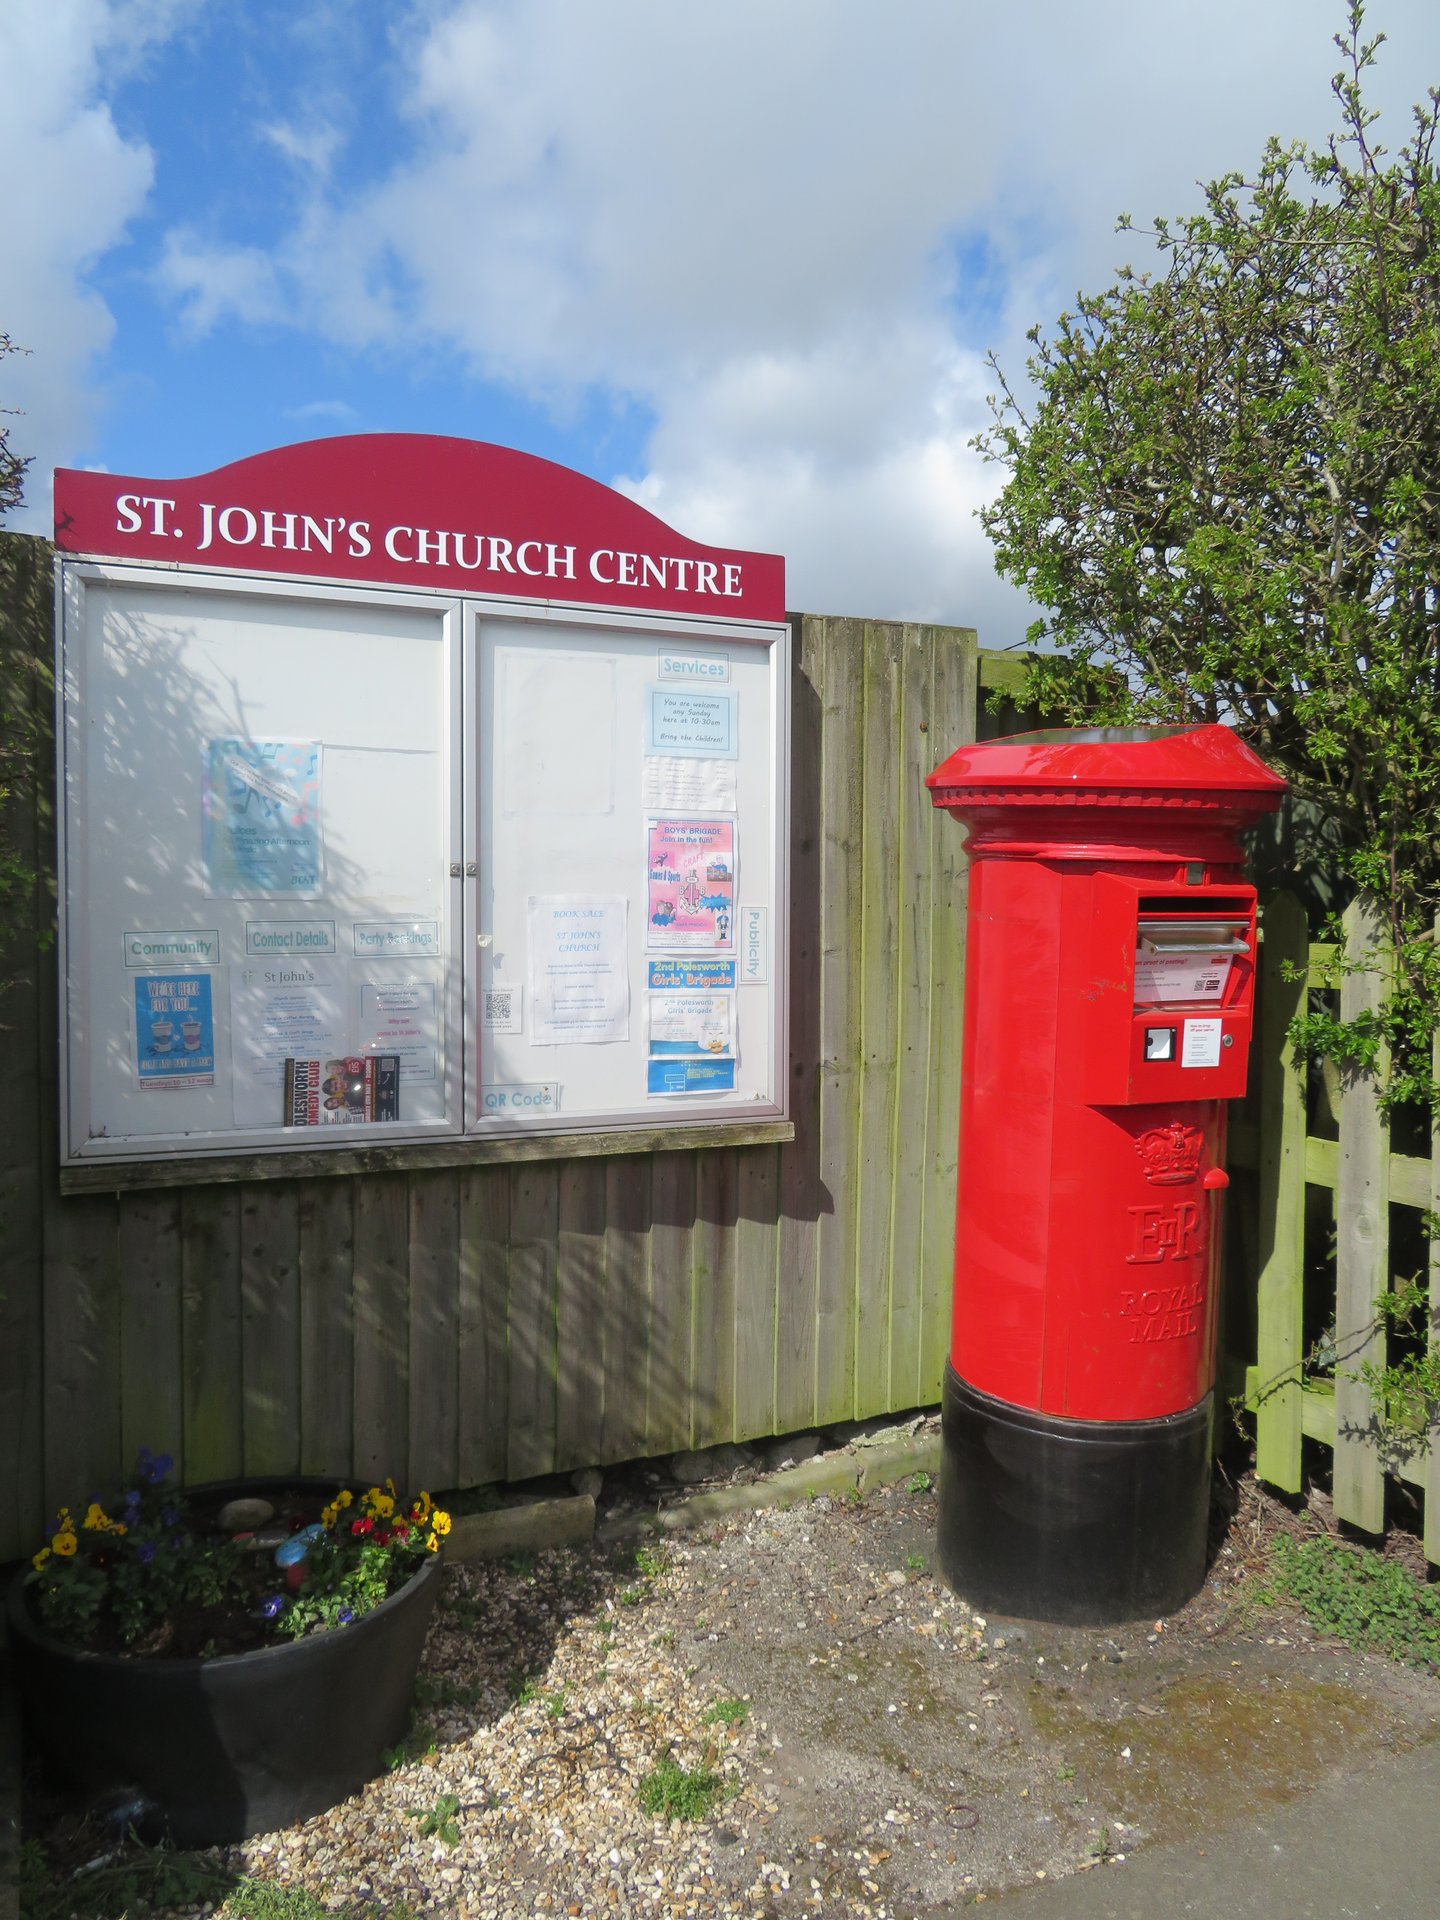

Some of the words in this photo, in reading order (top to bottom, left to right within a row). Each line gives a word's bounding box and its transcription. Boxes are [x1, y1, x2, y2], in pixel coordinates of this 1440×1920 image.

[116, 494, 183, 538] ST.
[197, 504, 371, 557] JOHN'S
[384, 526, 576, 580] CHURCH
[588, 549, 743, 598] CENTRE
[664, 657, 725, 676] Services
[664, 698, 677, 706] You
[693, 701, 720, 709] welcome
[662, 716, 677, 724] here
[673, 709, 684, 717] any
[688, 708, 711, 717] Sunday
[660, 733, 678, 741] Bring
[689, 827, 722, 836] BRIGADE
[553, 910, 581, 918] BOOK
[583, 910, 606, 918] SALE
[253, 931, 293, 947] Contact
[296, 930, 329, 946] Details
[360, 932, 385, 947] Party
[747, 911, 759, 976] Publicity
[131, 940, 212, 955] Community
[558, 943, 602, 952] CHURCH
[654, 961, 674, 971] 2nd
[677, 961, 731, 971] Polesworth
[264, 971, 276, 983] St
[279, 970, 315, 984] John's
[686, 973, 732, 987] Brigade
[178, 981, 200, 996] HERE
[308, 1061, 320, 1088] CLUB
[294, 1061, 309, 1126] OLESWORTH
[485, 1092, 506, 1108] QR
[511, 1091, 552, 1107] Code
[308, 1090, 319, 1126] OMEDY
[1120, 1281, 1203, 1316] ROYAL
[1128, 1311, 1197, 1344] MAIL
